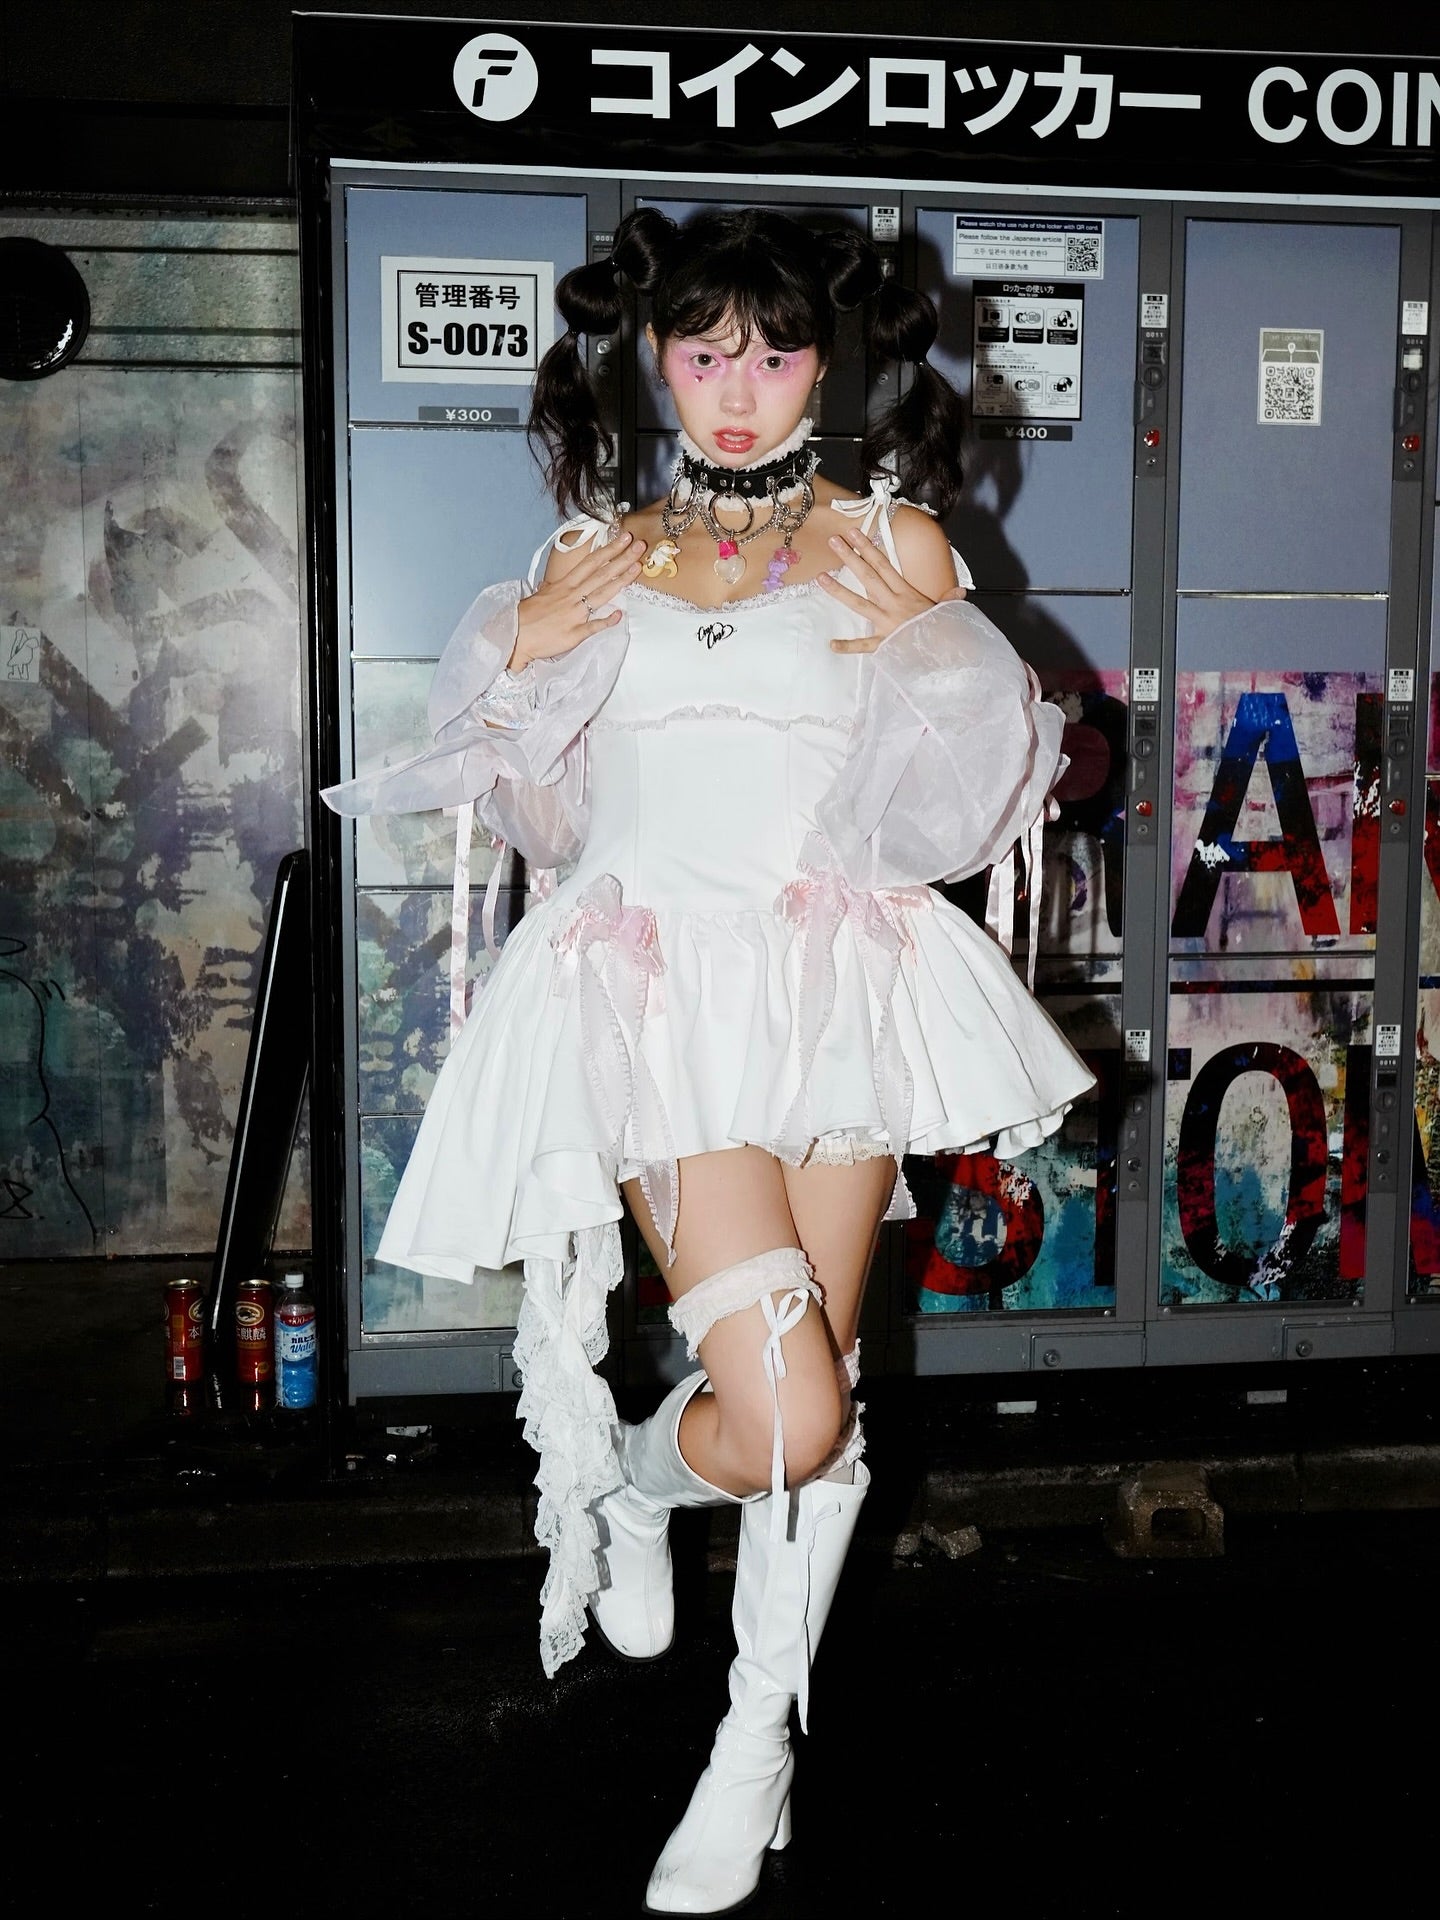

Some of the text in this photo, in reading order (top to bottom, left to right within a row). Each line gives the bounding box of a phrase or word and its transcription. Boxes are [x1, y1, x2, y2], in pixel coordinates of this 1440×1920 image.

[590, 43, 1201, 140] コインロッカー
[960, 220, 978, 228] Please
[980, 233, 998, 241] follow
[1012, 235, 1041, 244] Japanese
[415, 282, 521, 310] 管理番号
[1002, 284, 1055, 294] ロッカーの使い方
[407, 321, 528, 358] S-0073
[445, 408, 493, 422] ¥300
[1004, 426, 1048, 440] ¥400
